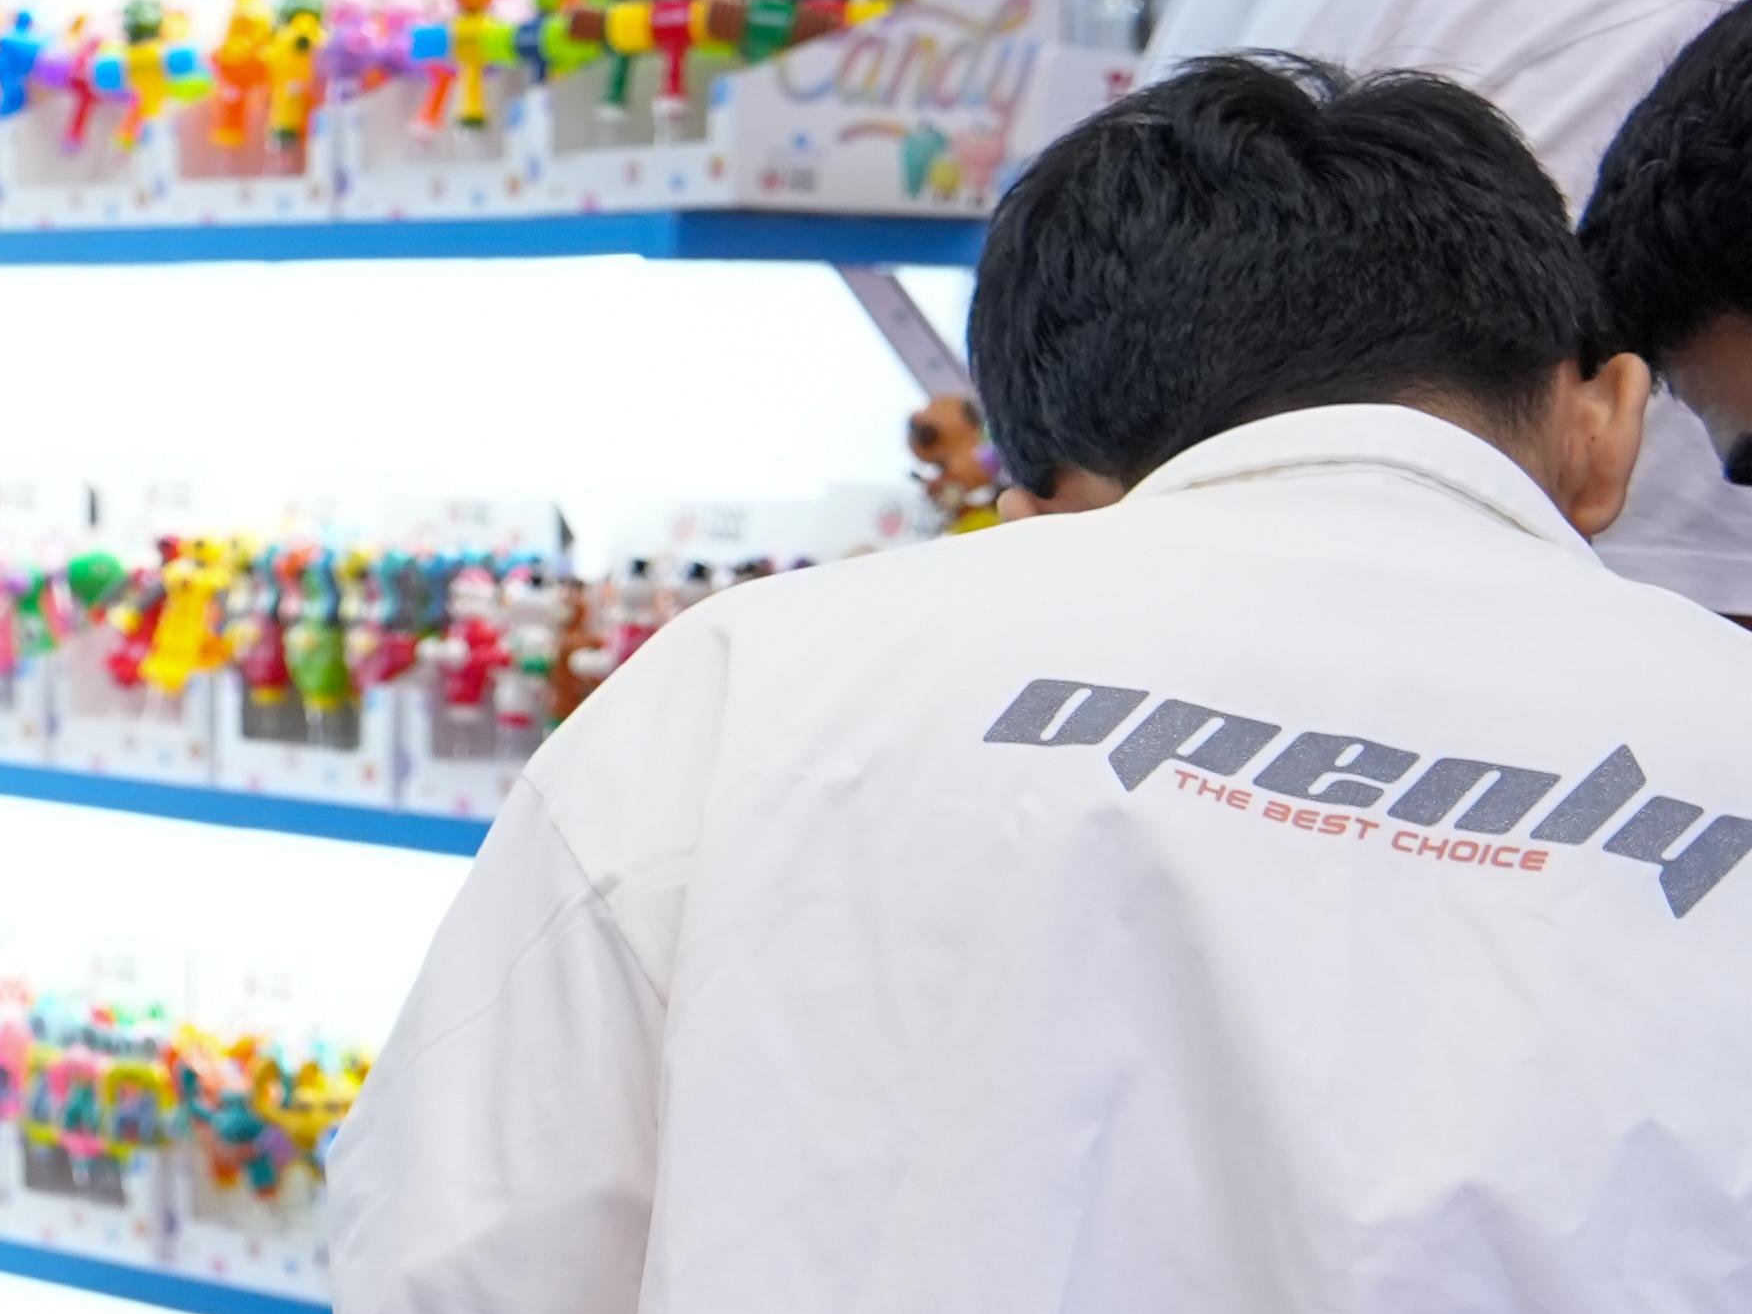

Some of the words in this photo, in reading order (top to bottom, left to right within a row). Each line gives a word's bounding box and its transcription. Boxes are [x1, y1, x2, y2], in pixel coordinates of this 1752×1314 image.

[982, 678, 1752, 919] openly
[1172, 769, 1254, 810] THE
[1262, 800, 1380, 840] BEST
[1390, 831, 1551, 872] CHOICE
